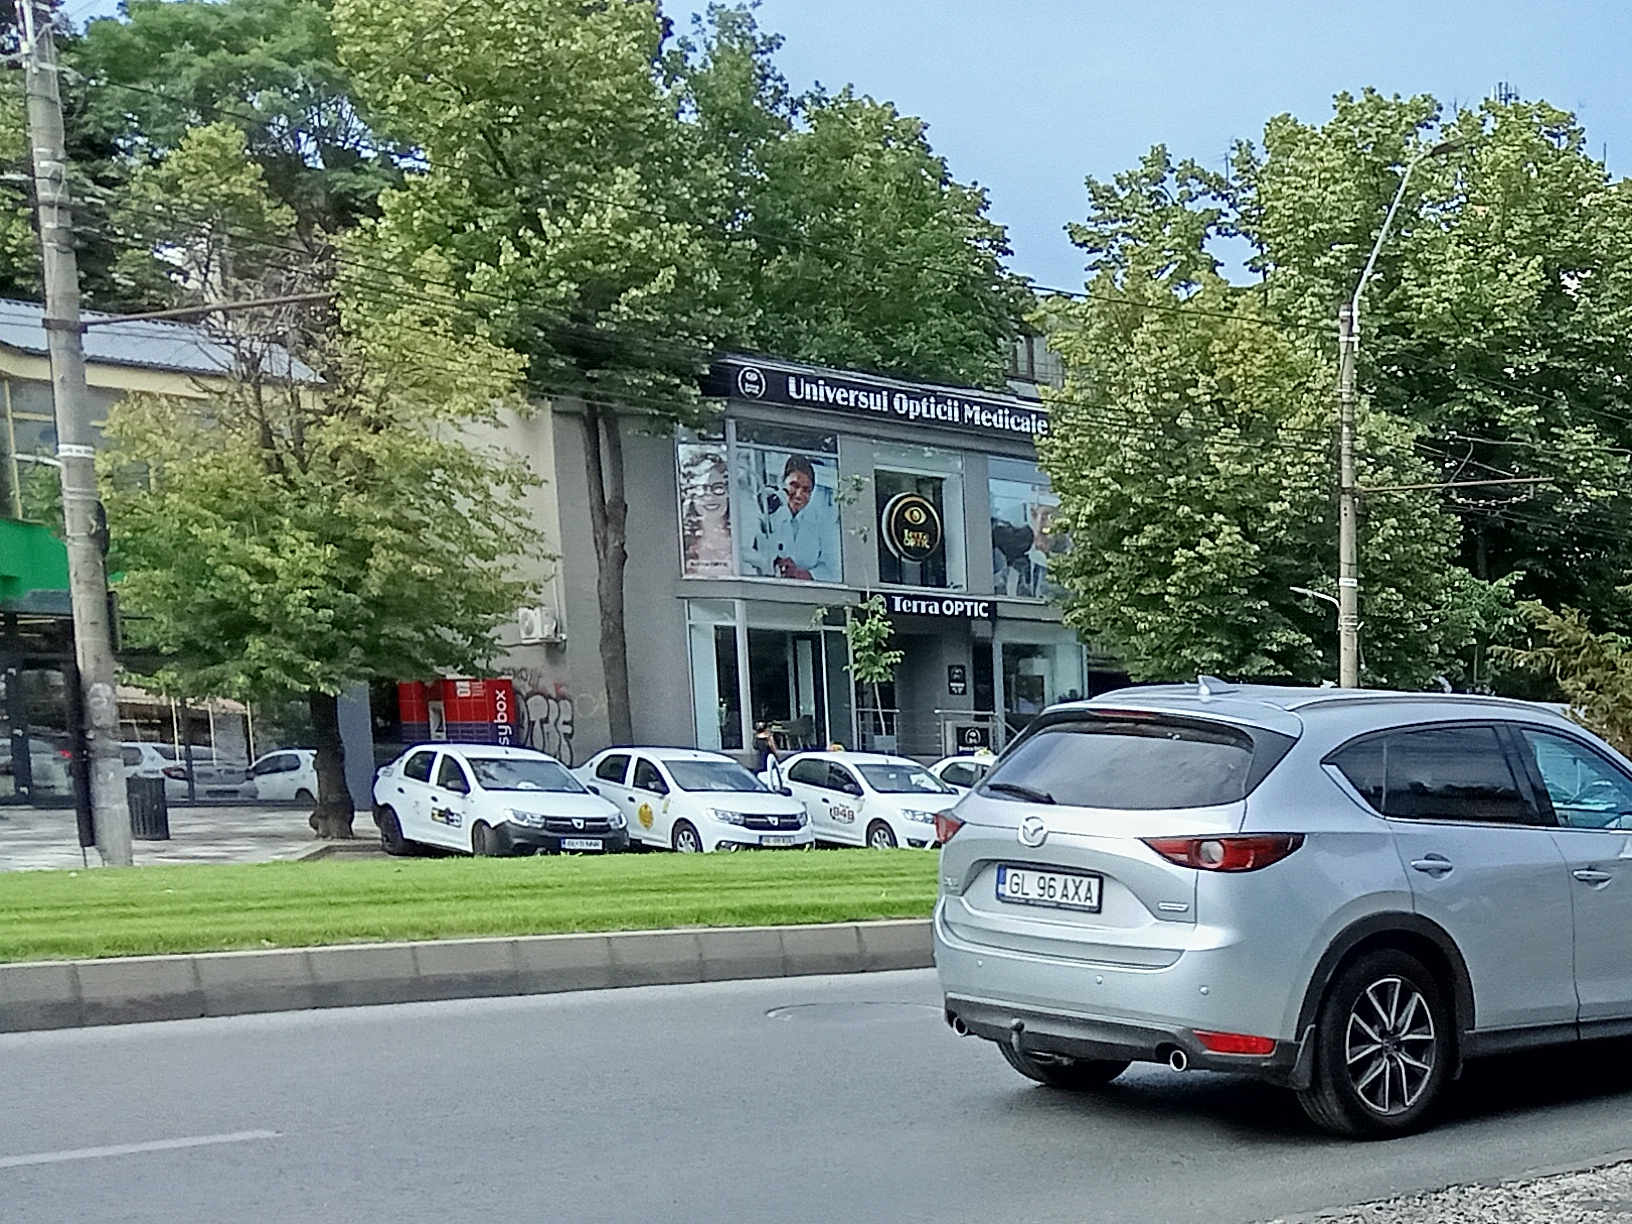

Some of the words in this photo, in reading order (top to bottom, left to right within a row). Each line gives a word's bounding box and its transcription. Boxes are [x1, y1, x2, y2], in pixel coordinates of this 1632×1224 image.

[893, 393, 960, 422] Opticii
[963, 403, 1049, 436] Medicale
[891, 595, 940, 614] Terra
[942, 600, 989, 618] OPTIC
[1008, 872, 1031, 897] GL
[1036, 876, 1057, 899] 96
[1060, 877, 1093, 904] AXA
